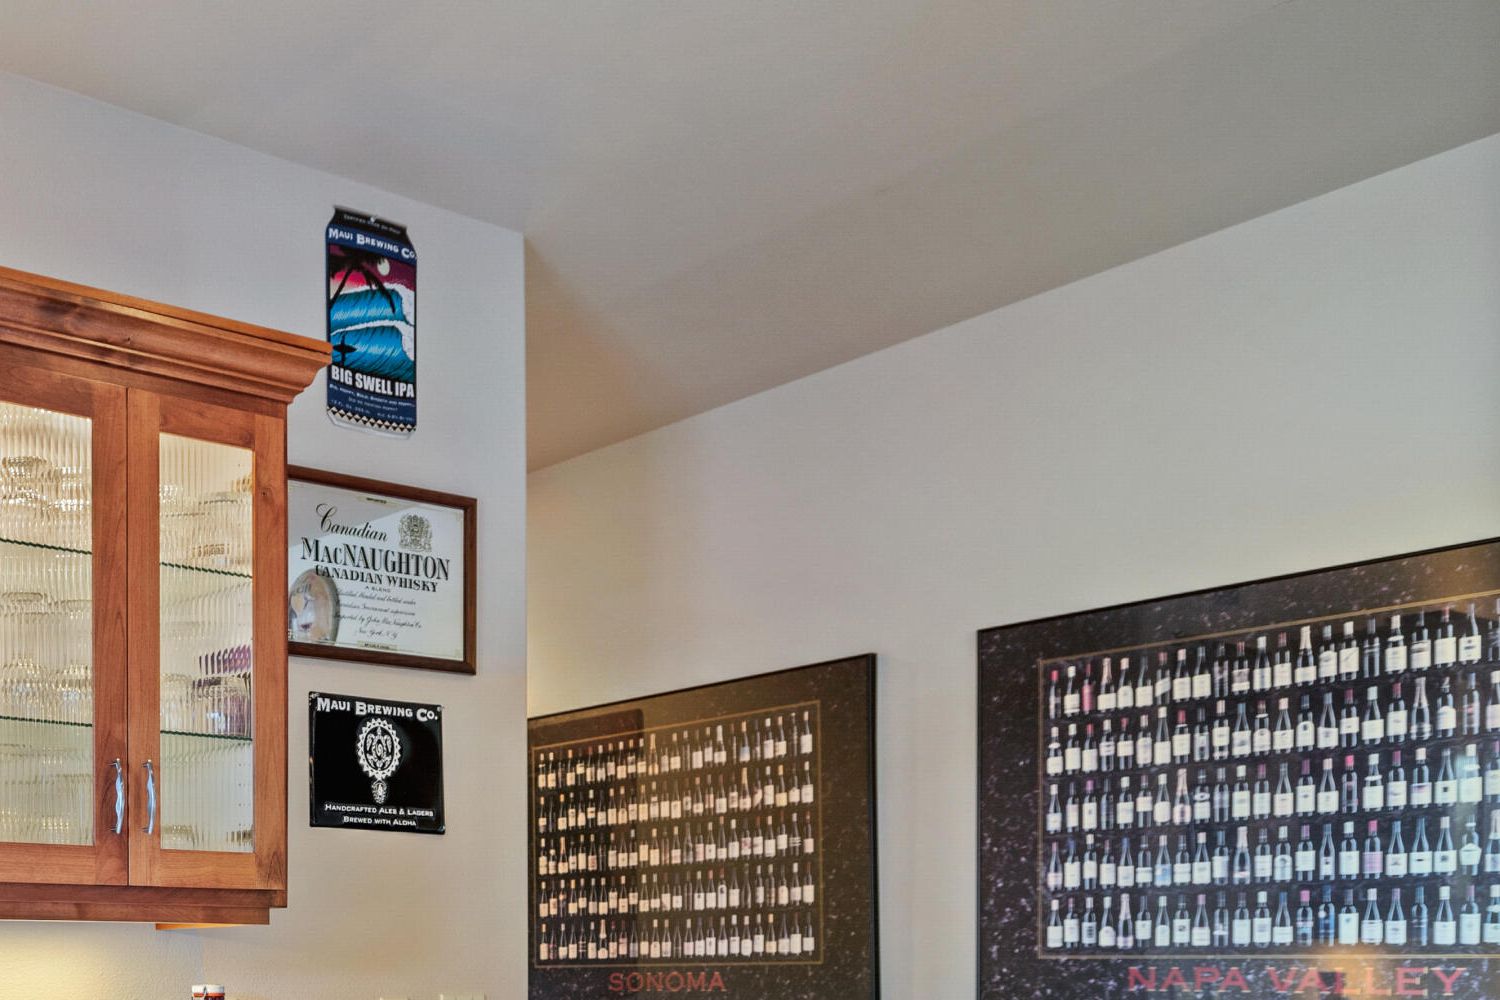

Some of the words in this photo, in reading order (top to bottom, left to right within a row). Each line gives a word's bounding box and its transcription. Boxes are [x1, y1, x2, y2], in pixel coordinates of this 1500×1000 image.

[328, 227, 353, 240] MAUI
[356, 233, 399, 253] BREWING
[331, 364, 353, 386] BIG
[355, 372, 393, 396] SWELL
[395, 381, 414, 398] IPA
[315, 503, 388, 542] Canadian
[315, 564, 383, 585] CANADIAN
[387, 575, 438, 593] WHISKY
[316, 697, 351, 712] MAUI
[355, 701, 413, 718] BREWING
[416, 708, 438, 722] CO.
[324, 803, 377, 814] HANDCRAFTED
[378, 807, 397, 815] ALES
[407, 809, 434, 817] LAGERS
[343, 815, 373, 824] BREWED
[392, 819, 417, 827] ALOHA
[608, 970, 727, 993] SONOMA
[1127, 966, 1251, 993] NAPA
[1265, 966, 1467, 996] VALLEY
